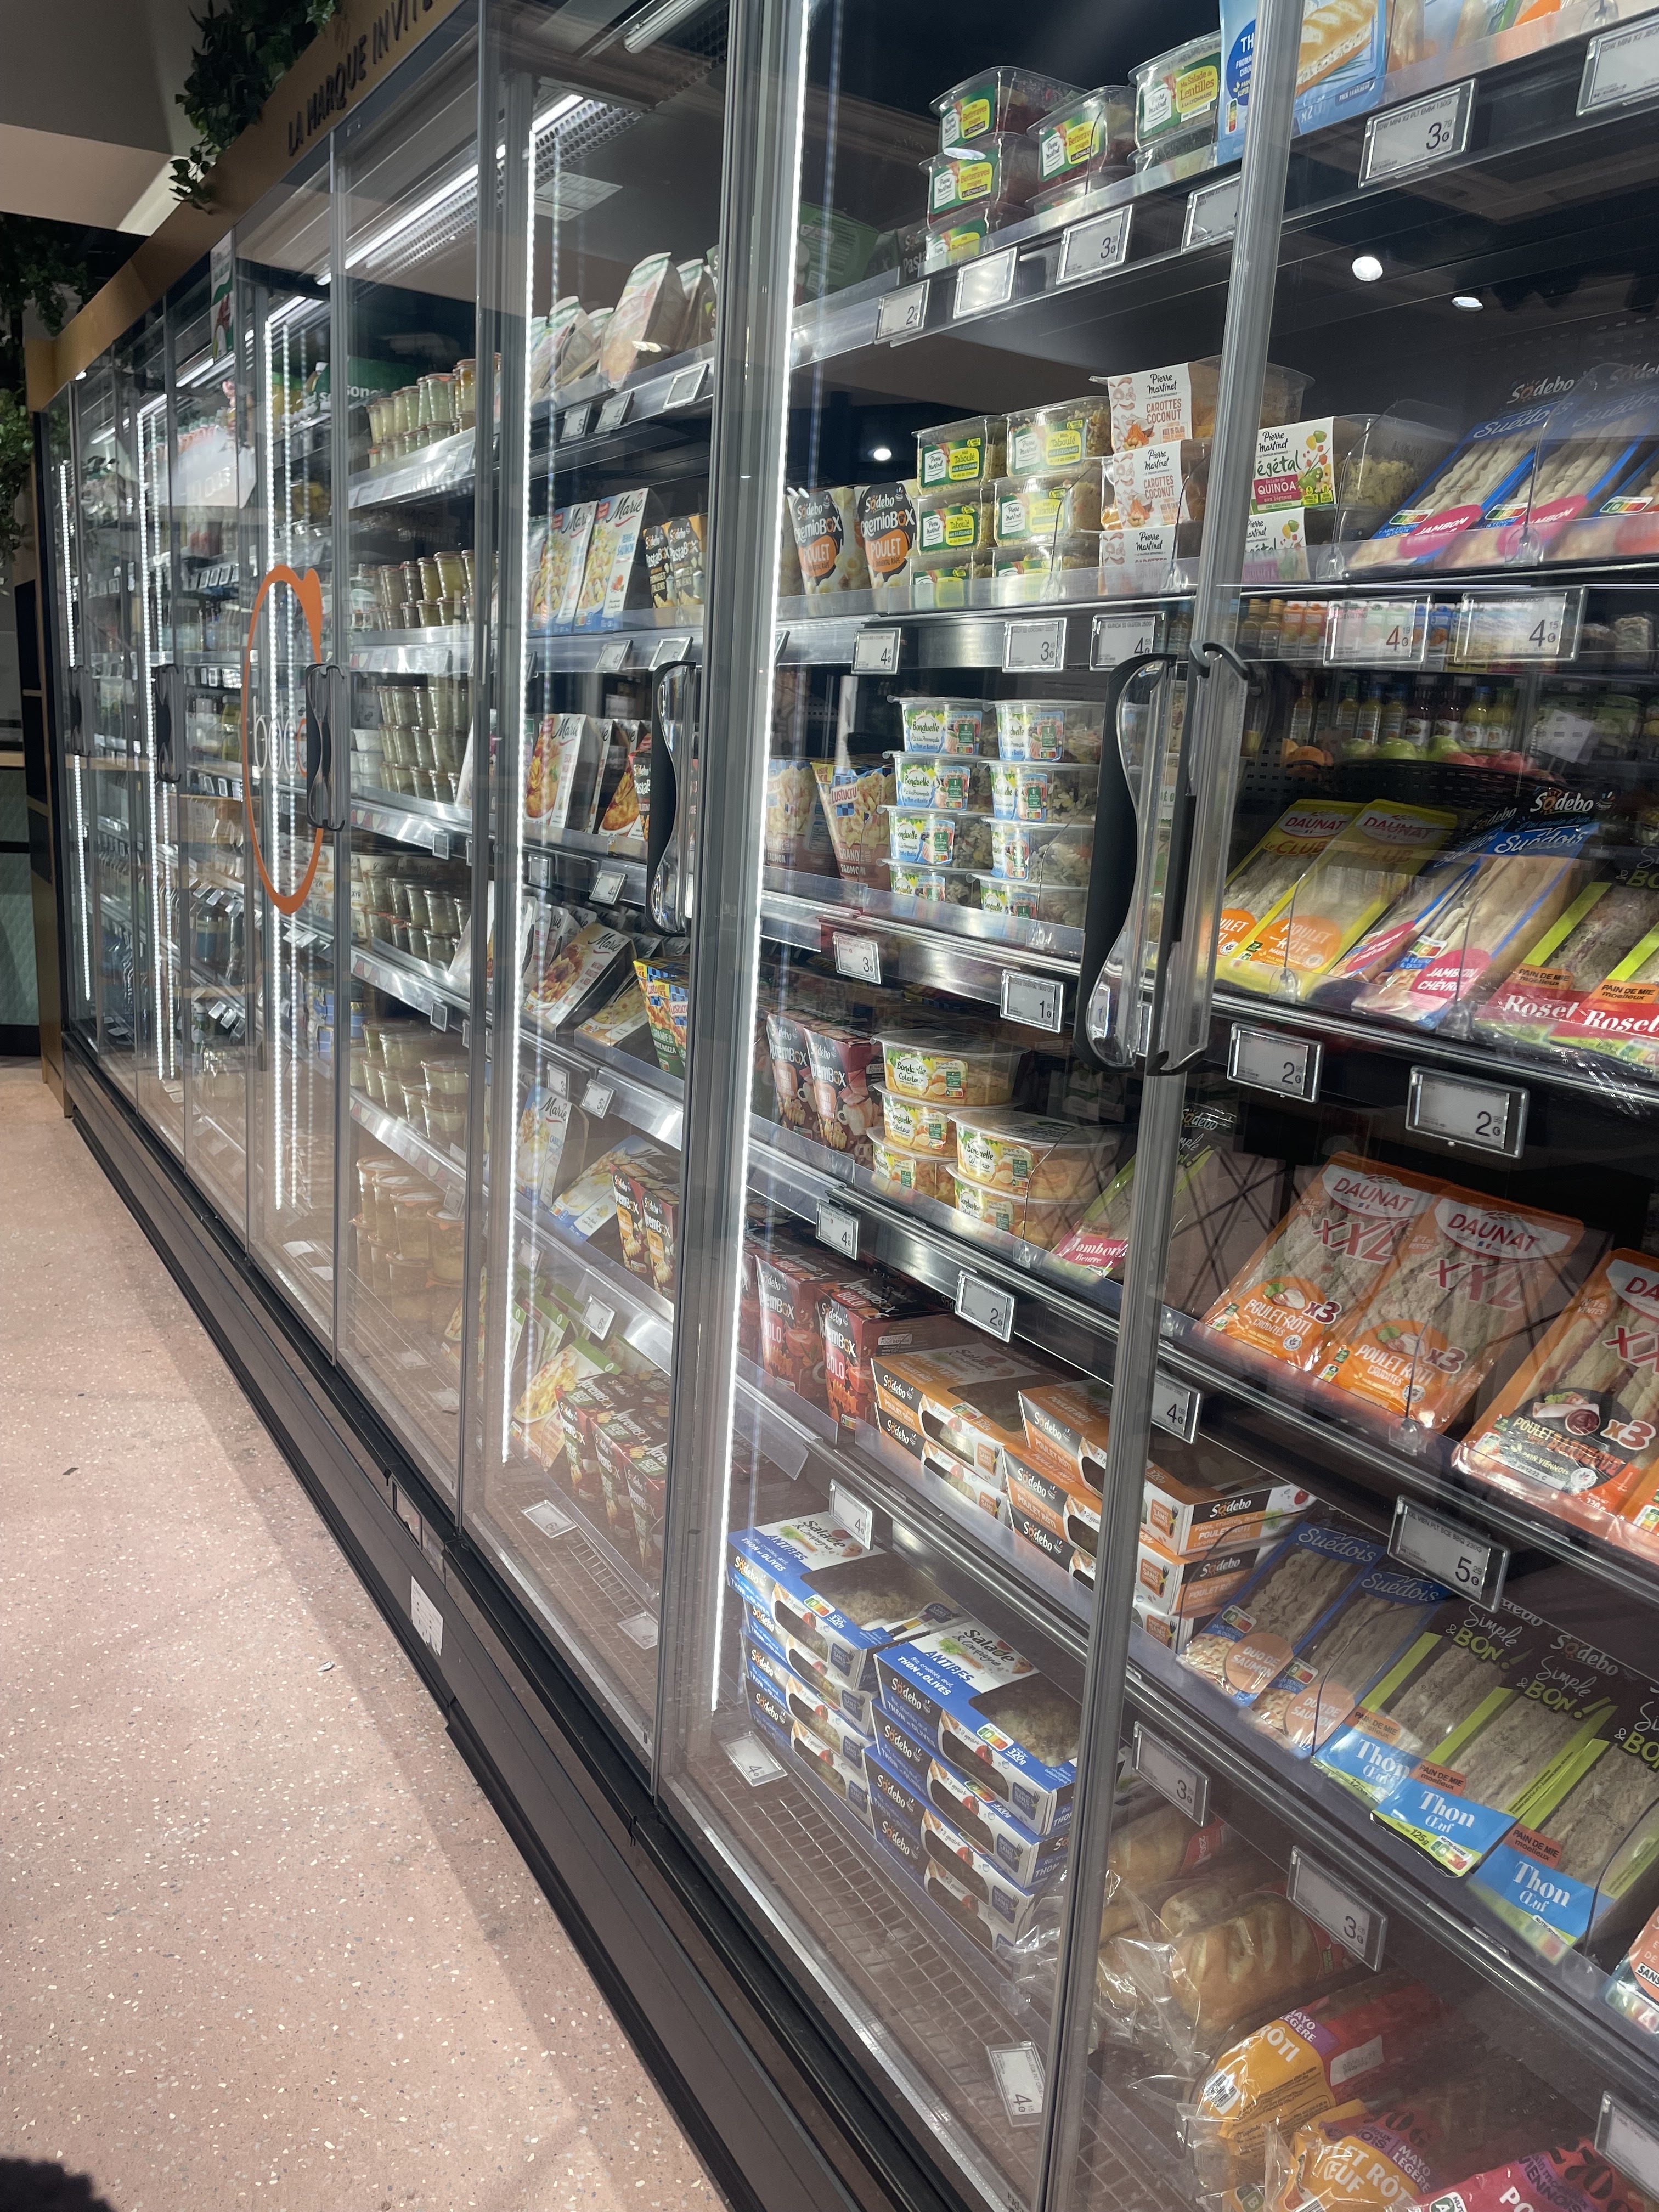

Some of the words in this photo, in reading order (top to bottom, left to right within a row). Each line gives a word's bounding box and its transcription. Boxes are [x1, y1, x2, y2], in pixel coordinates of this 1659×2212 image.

[1187, 70, 1206, 84] Salade
[289, 110, 303, 157] LA
[307, 34, 367, 137] MARQUE
[1180, 79, 1214, 101] Lentilles
[1389, 119, 1400, 129] MINI
[1147, 380, 1177, 394] Martinet
[1150, 373, 1173, 385] Pierre
[1506, 375, 1575, 405] Sodebo
[1146, 398, 1182, 413] CAROTTES
[1146, 409, 1181, 424] COCONUT
[1051, 436, 1076, 448] Taboulé
[1259, 438, 1289, 453] Martinet
[1262, 431, 1285, 443] Pierre
[954, 453, 975, 464] Taboulé
[1144, 456, 1170, 471] Martinet
[1148, 449, 1167, 461] Pierre
[1143, 475, 1174, 489] CAROTTES
[1144, 485, 1175, 500] COCONUT
[1257, 482, 1297, 495] QUINOA
[606, 495, 644, 523] Marie
[797, 501, 823, 521] Sodebo
[865, 494, 895, 514] Sodebo
[950, 518, 970, 529] Taboulé
[1415, 516, 1469, 538] JAMBON
[803, 543, 830, 563] POULET
[870, 537, 901, 560] POULET
[912, 721, 940, 733] Bonduelle
[905, 775, 930, 787] Bonduelle
[831, 785, 857, 804] Lustucru
[1530, 791, 1594, 814] Sodebo
[1284, 816, 1347, 831] DAUNAT
[1363, 817, 1437, 840] DAUNAT
[1276, 840, 1328, 856] CLUB
[1494, 828, 1588, 854] Suédois
[840, 863, 866, 876] SAUMON
[588, 932, 622, 951] Marie
[1427, 966, 1477, 979] JAMBON
[1518, 968, 1539, 979] PAIN
[1539, 972, 1554, 980] DE
[1554, 974, 1571, 983] MIE
[1601, 983, 1623, 995] PAIN
[1623, 986, 1638, 995] DE
[1638, 988, 1655, 997] MIE
[1601, 991, 1645, 1001] moelleux
[896, 1061, 927, 1075] Bonduelle
[899, 1072, 924, 1084] Coleslaw
[1333, 1177, 1414, 1214] DAUNAT
[1313, 1217, 1415, 1266] XXL
[1448, 1212, 1542, 1252] DAUNAT
[1071, 1237, 1122, 1257] Jambon
[1074, 1253, 1102, 1264] Beurre
[1427, 1257, 1528, 1312] XXL
[836, 1291, 867, 1307] BOLO
[821, 1302, 843, 1327] Sodebo
[1243, 1299, 1286, 1324] POULET
[1285, 1313, 1313, 1338] RÔTI
[1253, 1316, 1286, 1338] CRUDITÉS
[826, 1355, 844, 1380] BOLO
[1355, 1344, 1405, 1372] POULET
[883, 1374, 906, 1400] Sodebo
[884, 1399, 904, 1415] POULET
[887, 1420, 910, 1445] Sodebo
[1034, 1411, 1063, 1441] Sodebo
[1513, 1416, 1555, 1442] POULET
[978, 1450, 992, 1464] SANS
[1035, 1437, 1058, 1458] POULET
[1058, 1453, 1073, 1472] RÔTI
[1522, 1451, 1538, 1463] PAIN
[1017, 1468, 1047, 1498] Sodebo
[1017, 1493, 1042, 1515] POULET
[1042, 1511, 1057, 1528] RÔTI
[1153, 1508, 1169, 1523] SANS
[1209, 1498, 1252, 1519] Sodebo
[802, 1519, 847, 1549] Salade
[1023, 1521, 1053, 1551] Sodebo
[1440, 1527, 1453, 1538] SCE
[1466, 1541, 1483, 1553] 230G
[741, 1537, 759, 1553] THON
[761, 1552, 786, 1573] OLIVES
[766, 1534, 810, 1562] ANTIBES
[1297, 1528, 1378, 1565] Suédois
[1142, 1567, 1159, 1582] SANS
[1360, 1572, 1440, 1604] Suédois
[828, 1614, 845, 1630] 320g
[1211, 1623, 1223, 1633] PAIN
[1463, 1603, 1523, 1648] Simple
[963, 1628, 1015, 1664] Salade
[1243, 1646, 1263, 1662] DUO
[1265, 1654, 1281, 1666] DE
[1550, 1634, 1619, 1677] Sodebo
[751, 1649, 774, 1678] Sodebo
[923, 1650, 975, 1683] ANTIBES
[1231, 1655, 1275, 1679] SAUMON
[896, 1656, 917, 1675] THON
[922, 1673, 952, 1697] OLIVES
[1536, 1655, 1598, 1697] Simple
[890, 1678, 922, 1711] Sodebo
[755, 1692, 779, 1723] Sodebo
[1304, 1696, 1324, 1711] DUO
[1324, 1704, 1340, 1717] DE
[887, 1702, 906, 1720] THON
[910, 1723, 936, 1748] OLIVES
[1372, 1719, 1385, 1729] DE
[1384, 1726, 1398, 1736] MIE
[884, 1724, 912, 1759] Sodebo
[1006, 1747, 1027, 1767] 320g
[1355, 1738, 1412, 1778] Thon
[1419, 1764, 1438, 1777] PAIN
[1438, 1772, 1450, 1782] DE
[1450, 1776, 1465, 1787] MIE
[1420, 1773, 1455, 1790] moelleux
[877, 1774, 906, 1809] Sodebo
[1418, 1790, 1476, 1829] Thon
[1425, 1815, 1455, 1833] Œuf
[881, 1820, 910, 1856] Sodebo
[1410, 1828, 1430, 1846] 125g
[1440, 1836, 1466, 1857] NUTRI-SCORE
[1512, 1829, 1533, 1843] PAIN
[1533, 1839, 1544, 1849] DE
[1543, 1844, 1560, 1858] MIE
[1514, 1839, 1551, 1861] moelleux
[1512, 1860, 1571, 1908] Thon
[1519, 1890, 1550, 1913] Œuf
[1398, 2145, 1431, 2177] MAYO
